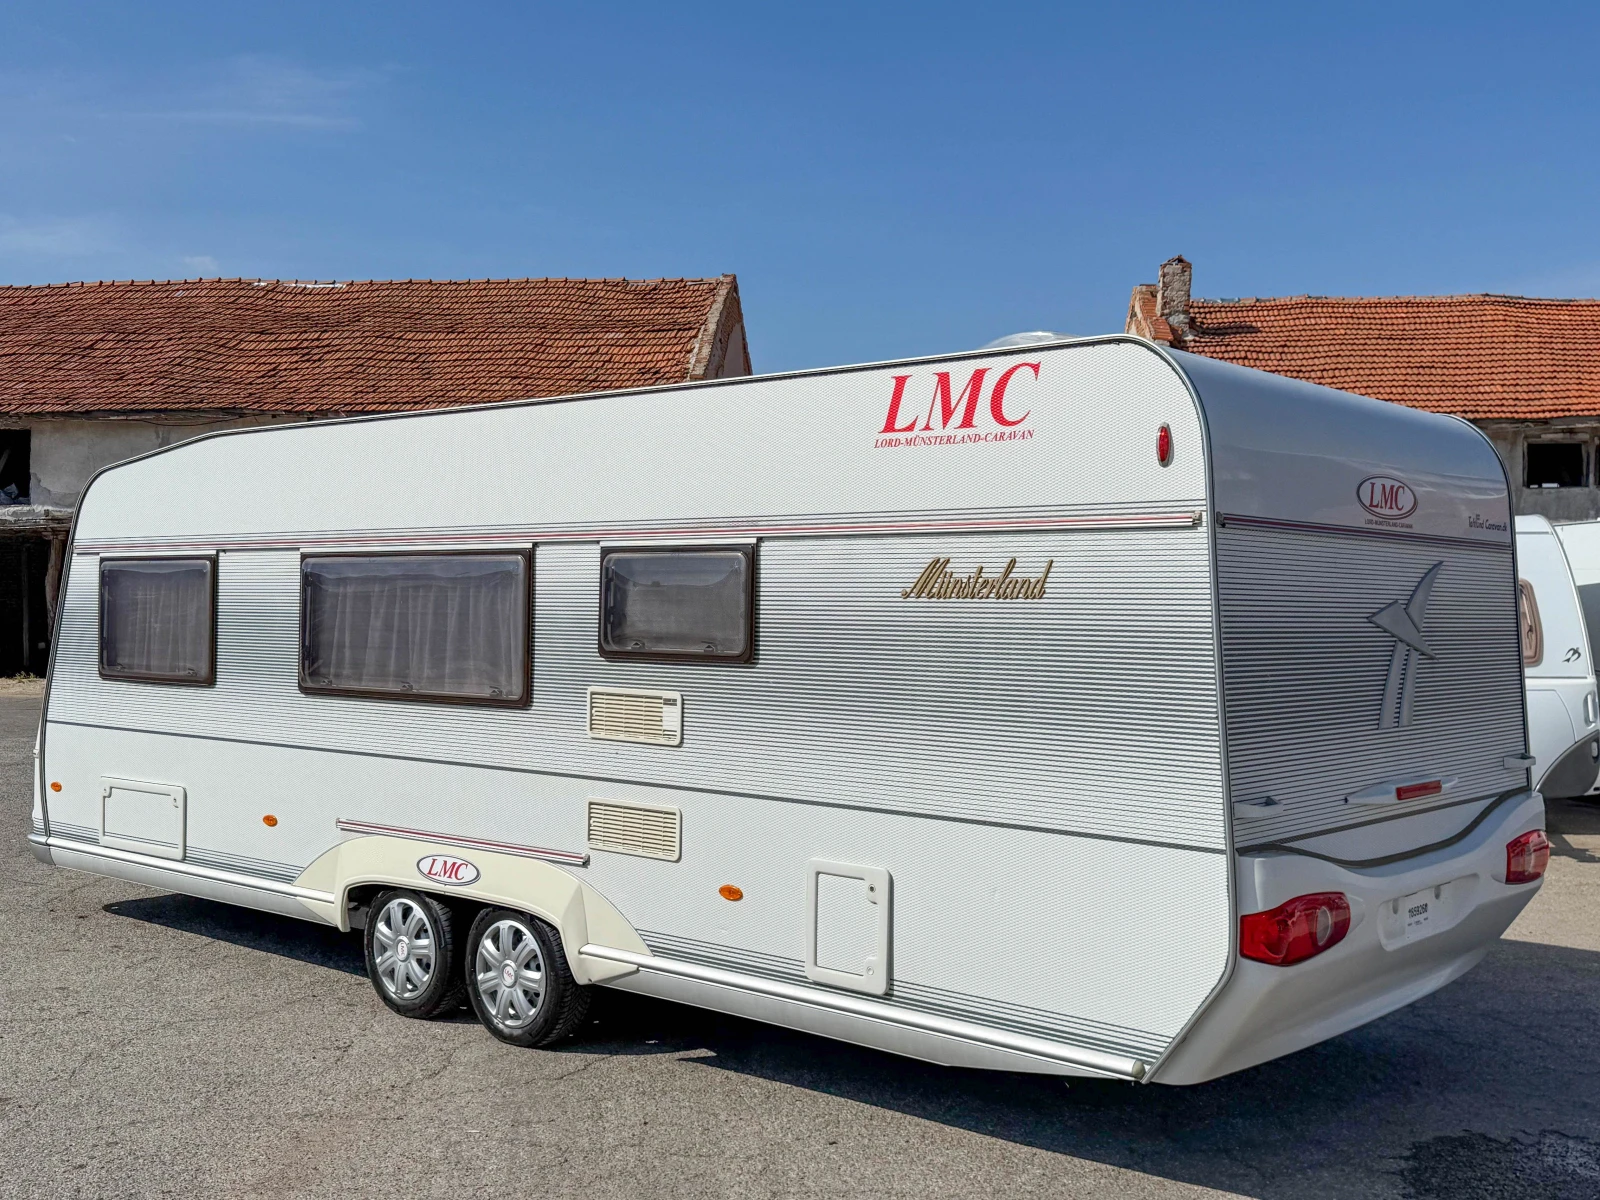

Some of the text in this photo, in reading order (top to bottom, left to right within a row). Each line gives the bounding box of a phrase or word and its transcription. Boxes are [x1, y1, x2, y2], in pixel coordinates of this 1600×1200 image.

[878, 361, 1041, 433] LMC
[874, 429, 1035, 449] LORD-MÜNSTERLAND-CARAVAN
[1368, 482, 1405, 511] LMC
[901, 557, 1054, 599] Münsterland
[427, 858, 468, 880] LMC
